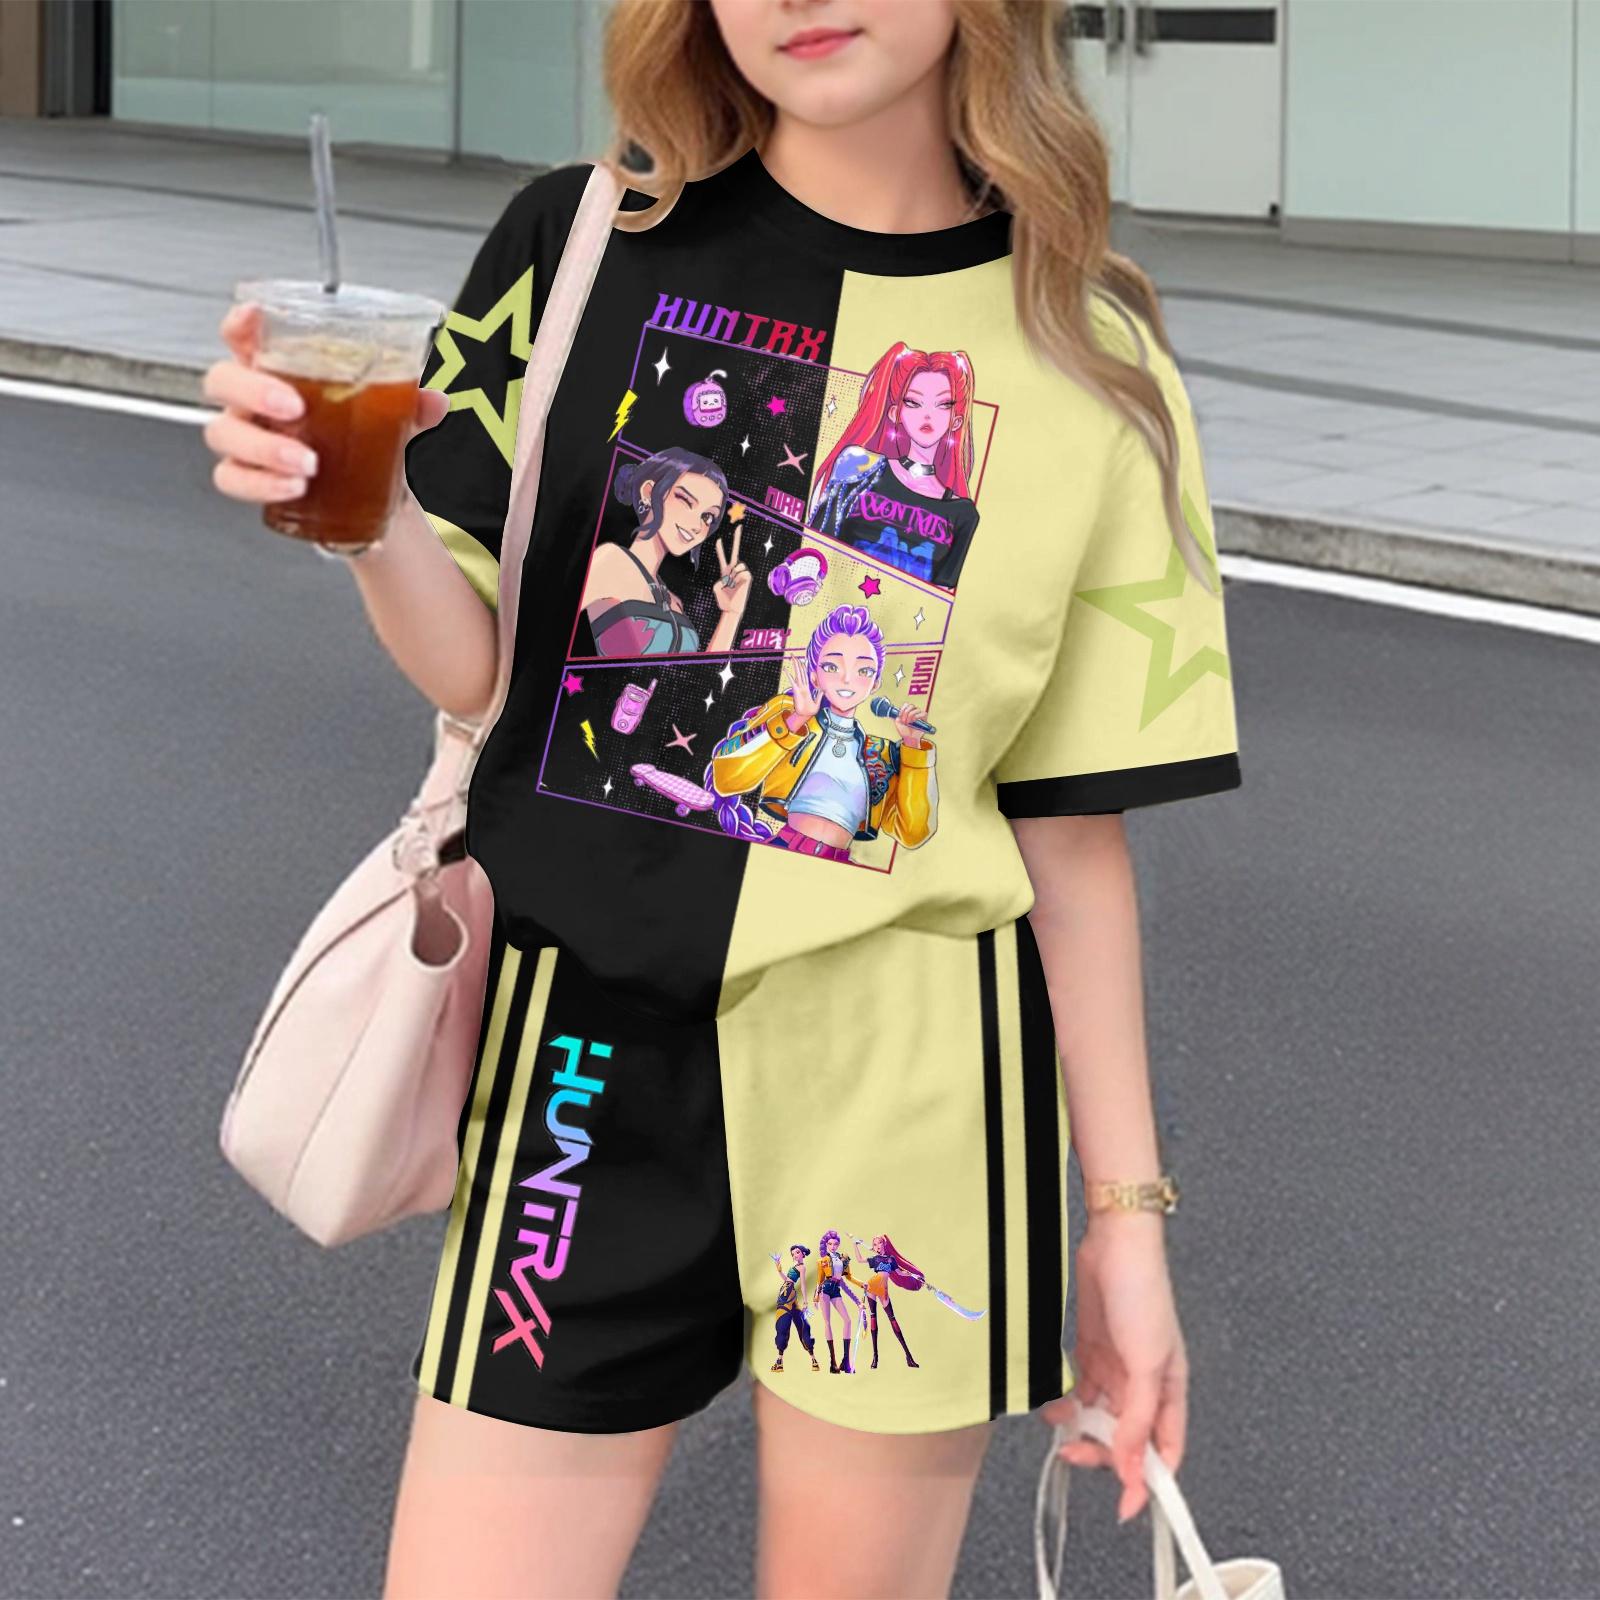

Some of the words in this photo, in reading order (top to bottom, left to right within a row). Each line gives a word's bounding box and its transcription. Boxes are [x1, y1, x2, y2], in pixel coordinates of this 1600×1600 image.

[648, 292, 827, 362] HUNTRX
[740, 628, 791, 648] ZOEY
[908, 656, 936, 696] RUMI
[491, 1034, 613, 1371] HUNTRX
